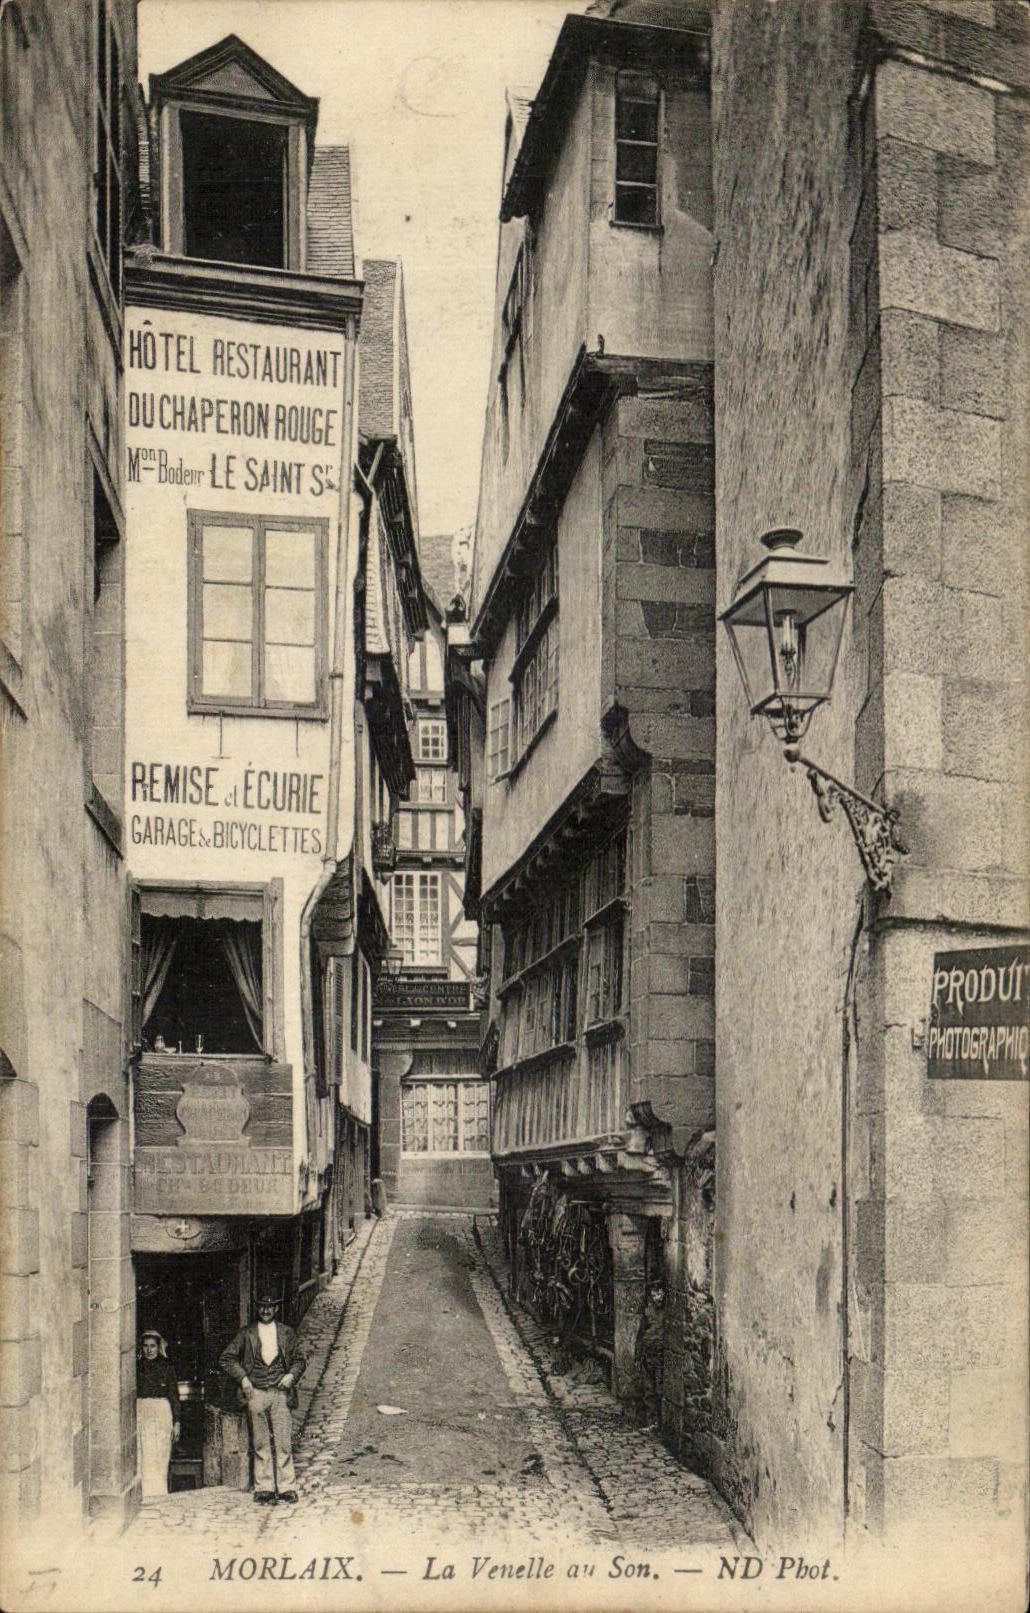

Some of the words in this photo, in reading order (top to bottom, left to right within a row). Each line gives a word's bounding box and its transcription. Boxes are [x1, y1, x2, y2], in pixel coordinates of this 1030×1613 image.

[129, 320, 200, 373] HÔTEL
[212, 338, 341, 387] RESTAURANT
[128, 392, 154, 428] DU
[159, 394, 268, 438] CHAPERON
[273, 404, 337, 446] ROUGE
[210, 453, 236, 489] LE
[244, 458, 305, 494] SAINT
[131, 761, 219, 806] REMISE
[243, 762, 323, 814] ÉCURIE
[131, 814, 197, 847] GARAGE
[213, 820, 322, 854] BICYCLETTES
